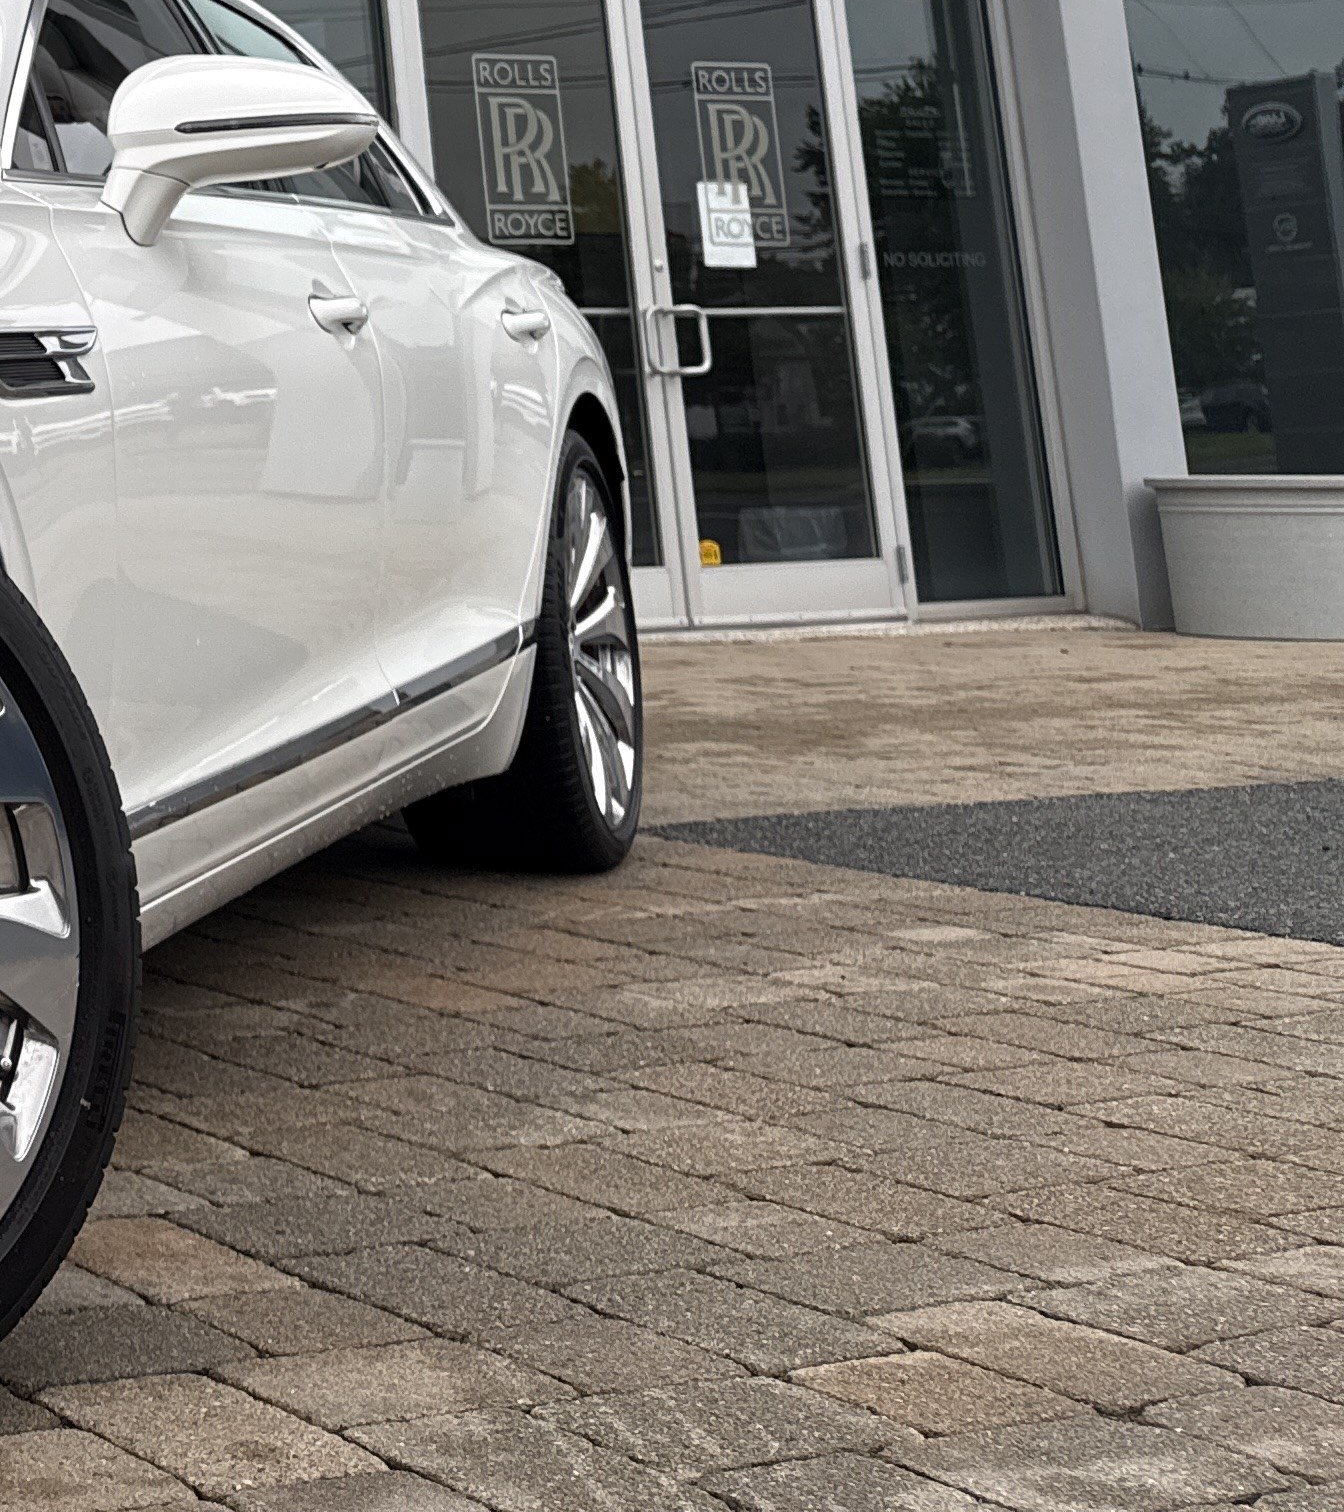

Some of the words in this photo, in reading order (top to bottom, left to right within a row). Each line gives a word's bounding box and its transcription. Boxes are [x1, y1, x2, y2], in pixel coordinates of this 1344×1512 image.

[478, 61, 552, 86] ROLLS
[697, 69, 767, 93] ROLLS
[494, 213, 568, 236] ROYCE
[883, 251, 906, 268] NO
